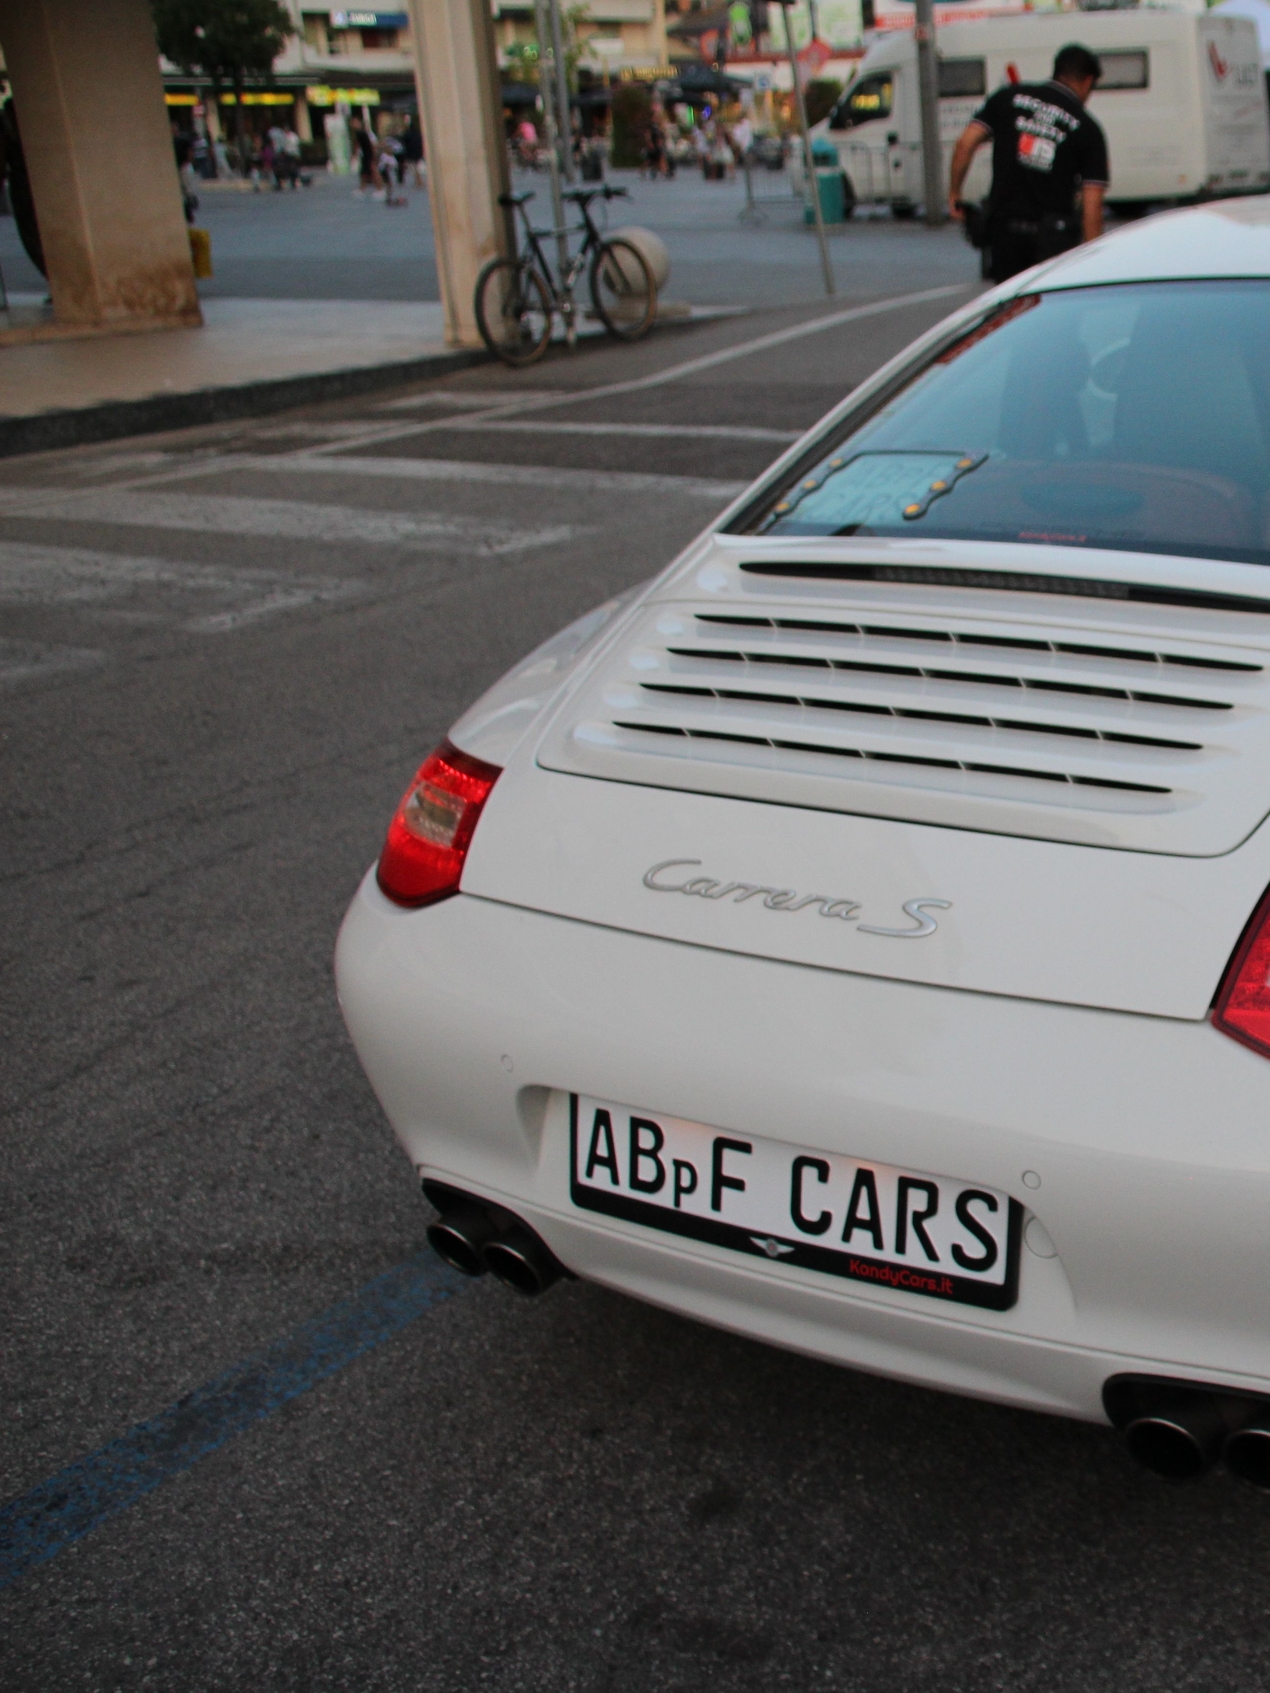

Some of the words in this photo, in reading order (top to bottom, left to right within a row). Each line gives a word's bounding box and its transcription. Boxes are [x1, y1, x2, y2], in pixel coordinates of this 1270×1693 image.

[643, 859, 861, 920] Carrera
[857, 898, 952, 938] S
[790, 1155, 999, 1272] CARS
[849, 1259, 954, 1294] KandyCars.it
